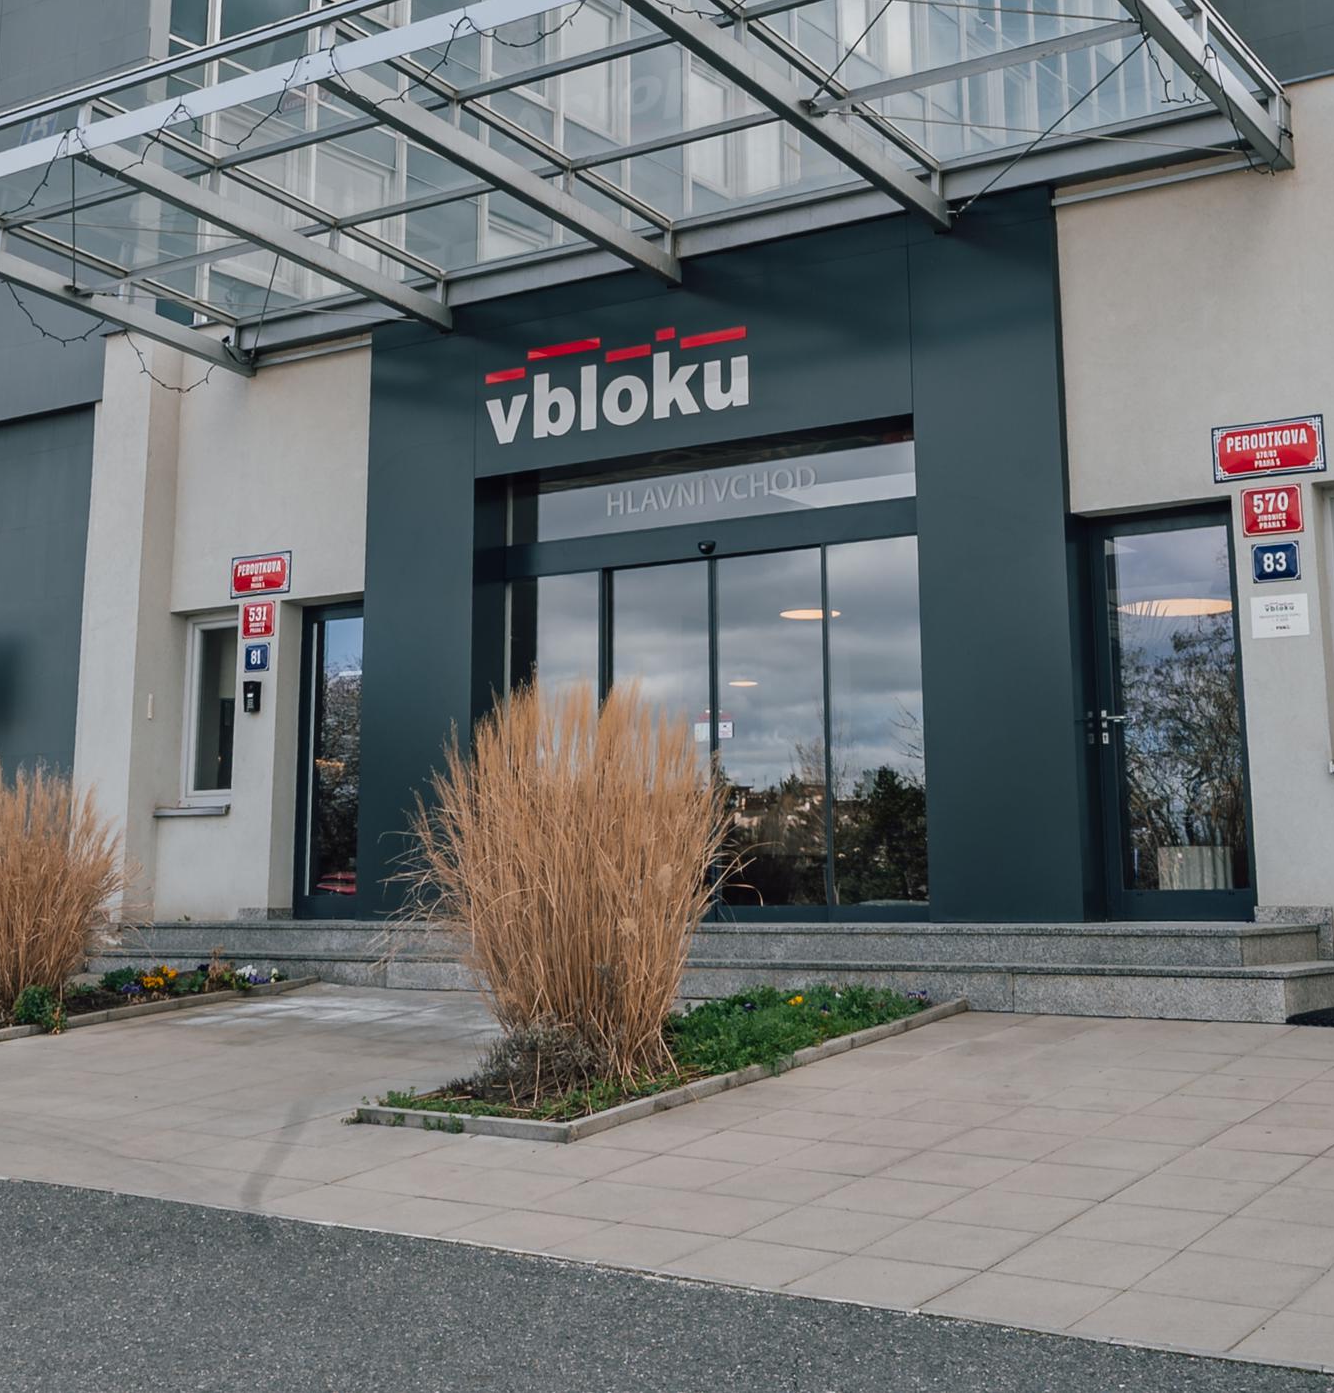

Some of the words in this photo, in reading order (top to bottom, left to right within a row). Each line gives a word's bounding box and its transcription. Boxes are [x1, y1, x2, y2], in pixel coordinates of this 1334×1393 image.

[486, 351, 750, 445] vbloku
[1226, 428, 1308, 453] PEROUTKOVA
[1254, 459, 1275, 468] PRAHA
[606, 473, 705, 518] HLAVNÍ
[713, 465, 817, 504] VCHOD
[1253, 492, 1289, 514] 570
[237, 561, 281, 576] PEROUTKOVA
[1263, 551, 1287, 573] 83
[249, 607, 267, 621] 531
[250, 649, 262, 665] 81
